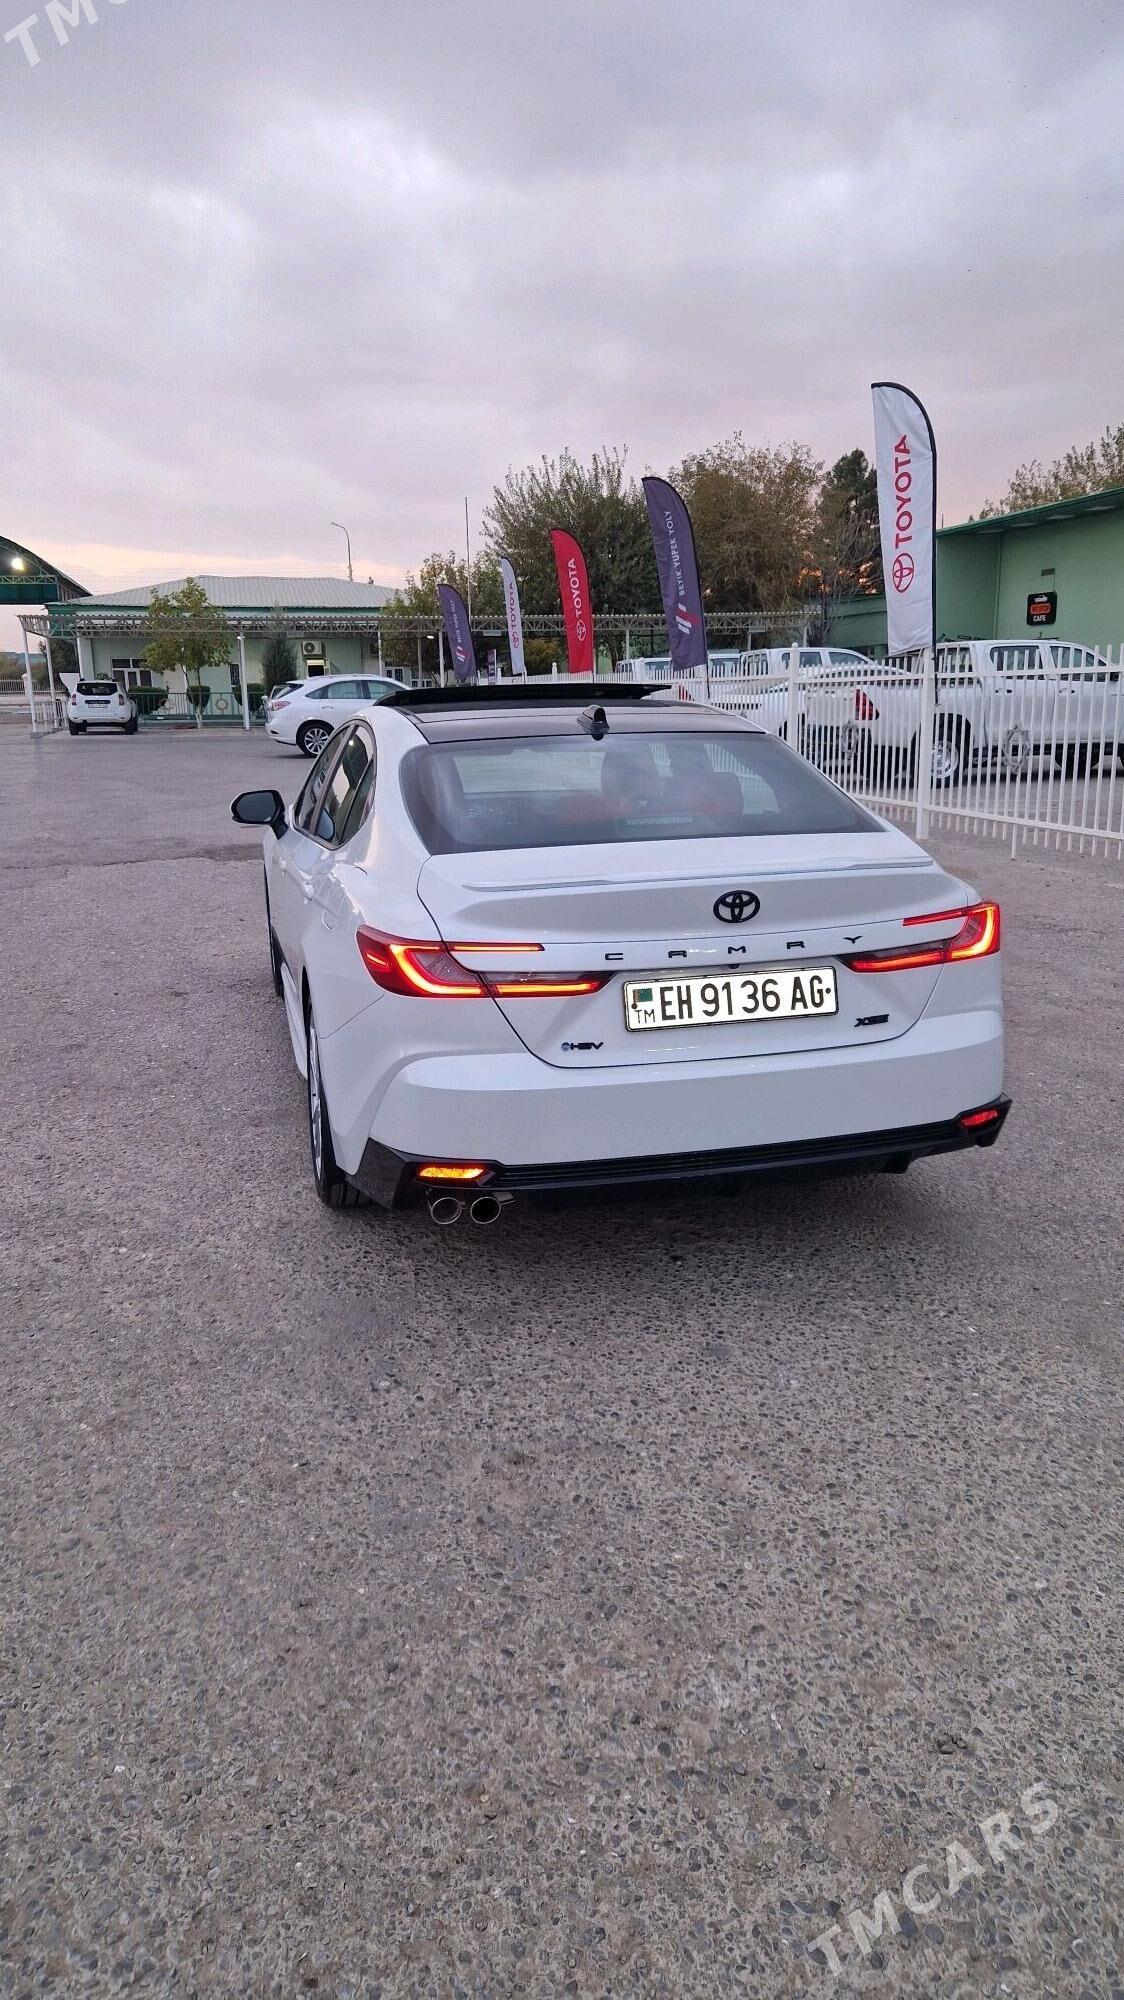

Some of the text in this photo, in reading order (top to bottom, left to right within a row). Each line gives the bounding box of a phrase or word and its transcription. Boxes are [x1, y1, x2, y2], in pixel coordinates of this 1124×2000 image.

[894, 434, 914, 549] TOYOTA
[508, 582, 517, 628] TOYOTA
[567, 558, 583, 618] TOYOTA
[1033, 614, 1047, 622] CAFE
[604, 935, 864, 961] CAMRY
[634, 1008, 656, 1024] TM
[660, 985, 694, 1021] EH
[790, 975, 825, 1011] AG
